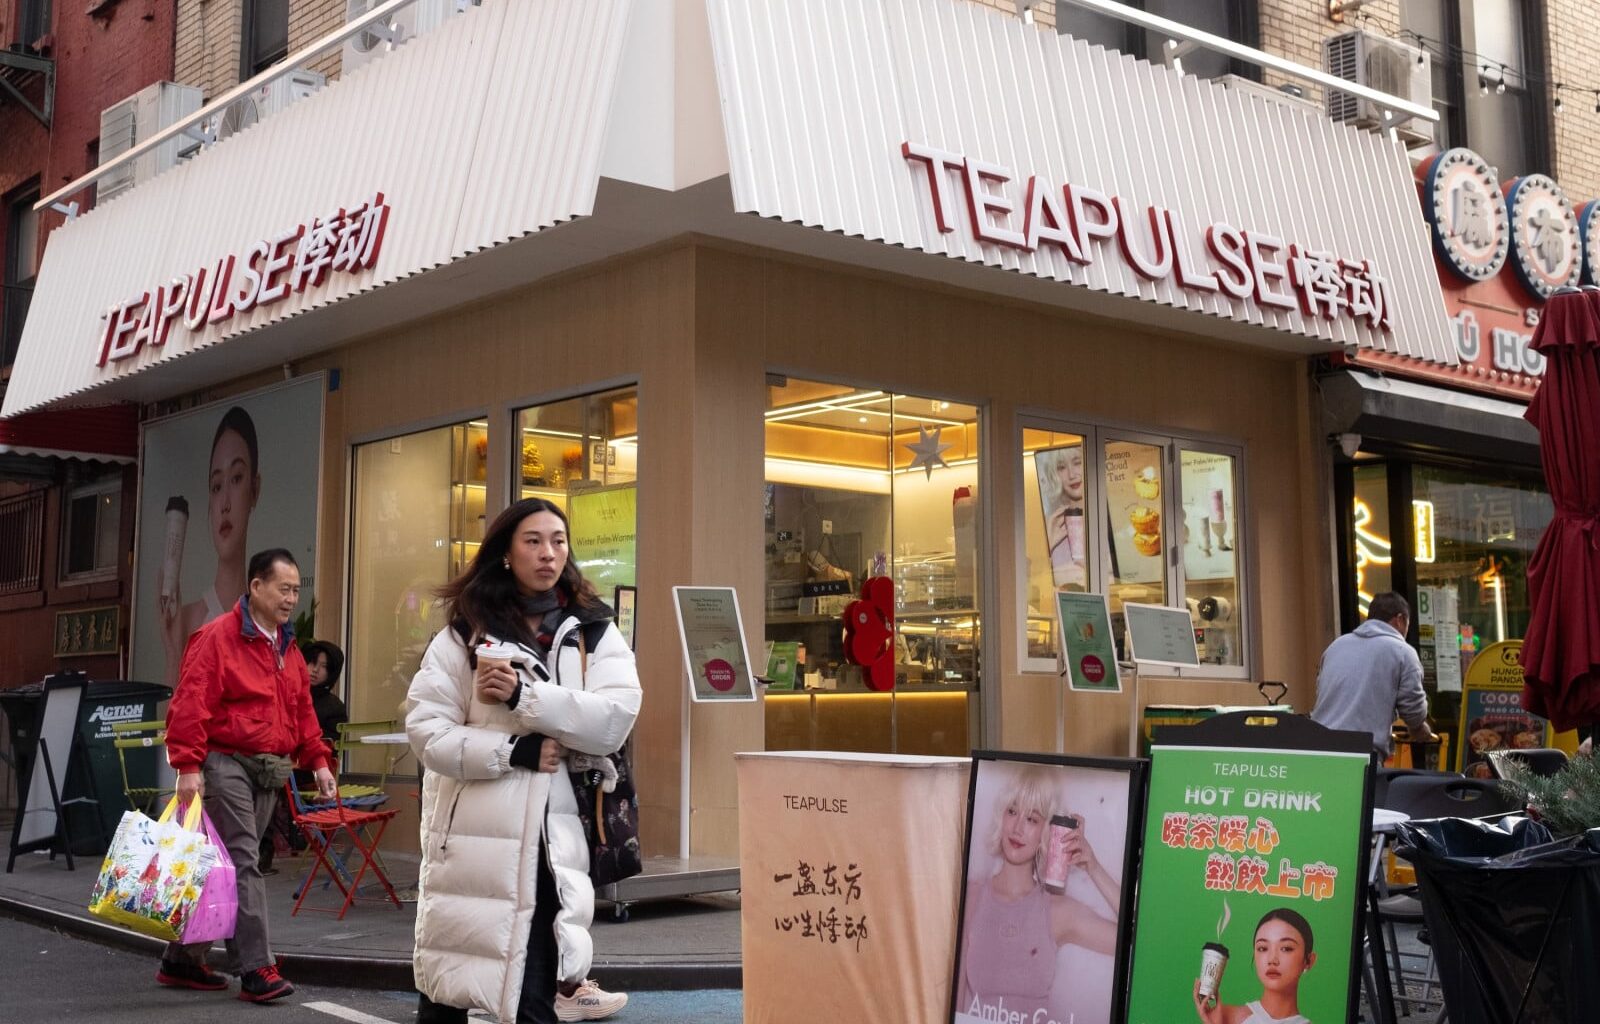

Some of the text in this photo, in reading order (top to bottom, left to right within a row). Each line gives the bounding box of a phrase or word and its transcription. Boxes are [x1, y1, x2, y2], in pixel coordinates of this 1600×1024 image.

[901, 140, 1298, 311] TEAPULSE
[1288, 243, 1395, 333] 悸动
[96, 191, 391, 367] TEAPULSE 悸动
[1492, 327, 1548, 377] HO
[1104, 450, 1131, 461] Lemon
[1105, 460, 1129, 472] Cloud
[1107, 472, 1126, 482] Tart
[813, 584, 840, 593] OPEN
[1419, 591, 1429, 614] B
[1491, 667, 1525, 676] HUNGR
[88, 703, 145, 723] ACTION
[1213, 763, 1289, 779] TEAPULSE
[783, 795, 849, 814] TEAPULSE
[1184, 785, 1322, 812] HOT DRINK
[1161, 812, 1280, 854] 暖茶暖心
[1205, 852, 1338, 901] 熱飲上市
[774, 906, 868, 953] 心生悸动
[967, 992, 1029, 1024] Amber
